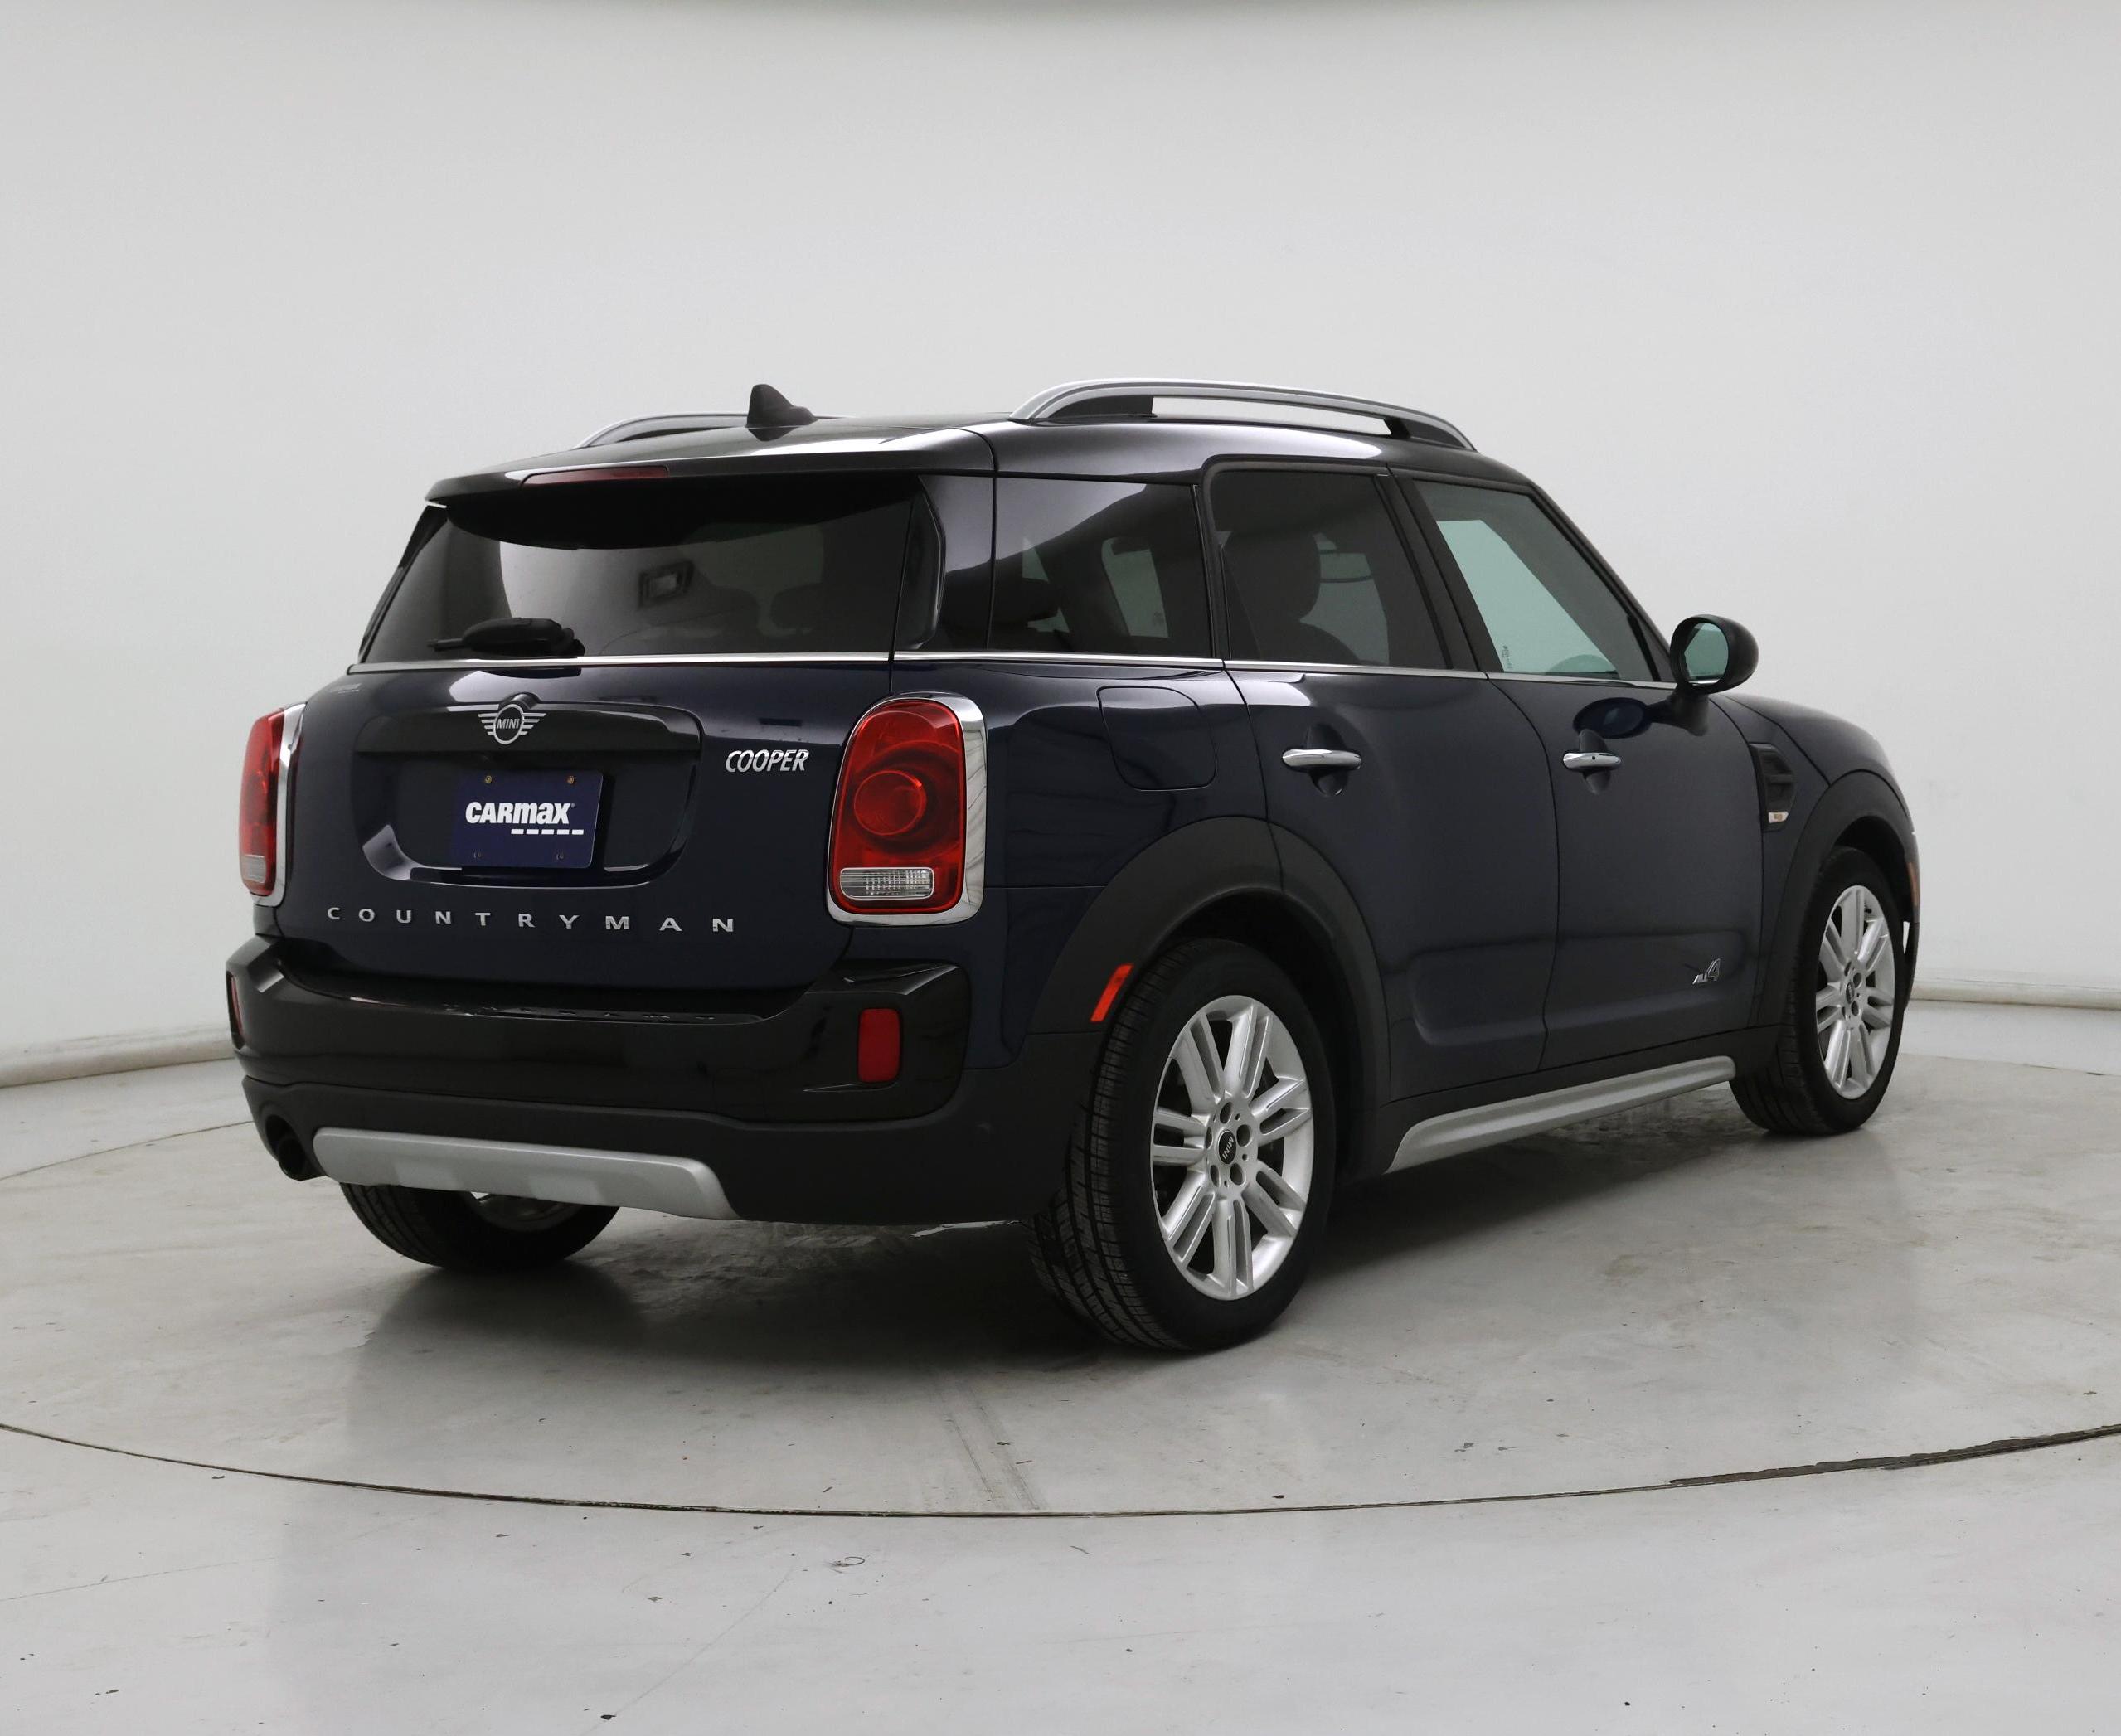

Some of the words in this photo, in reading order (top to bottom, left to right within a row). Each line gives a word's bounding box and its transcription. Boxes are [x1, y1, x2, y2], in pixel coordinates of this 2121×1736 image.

[497, 719, 520, 729] MINI
[726, 749, 809, 773] COOPER
[328, 907, 734, 933] COUNTRYMAN
[1222, 1136, 1234, 1159] MINI
